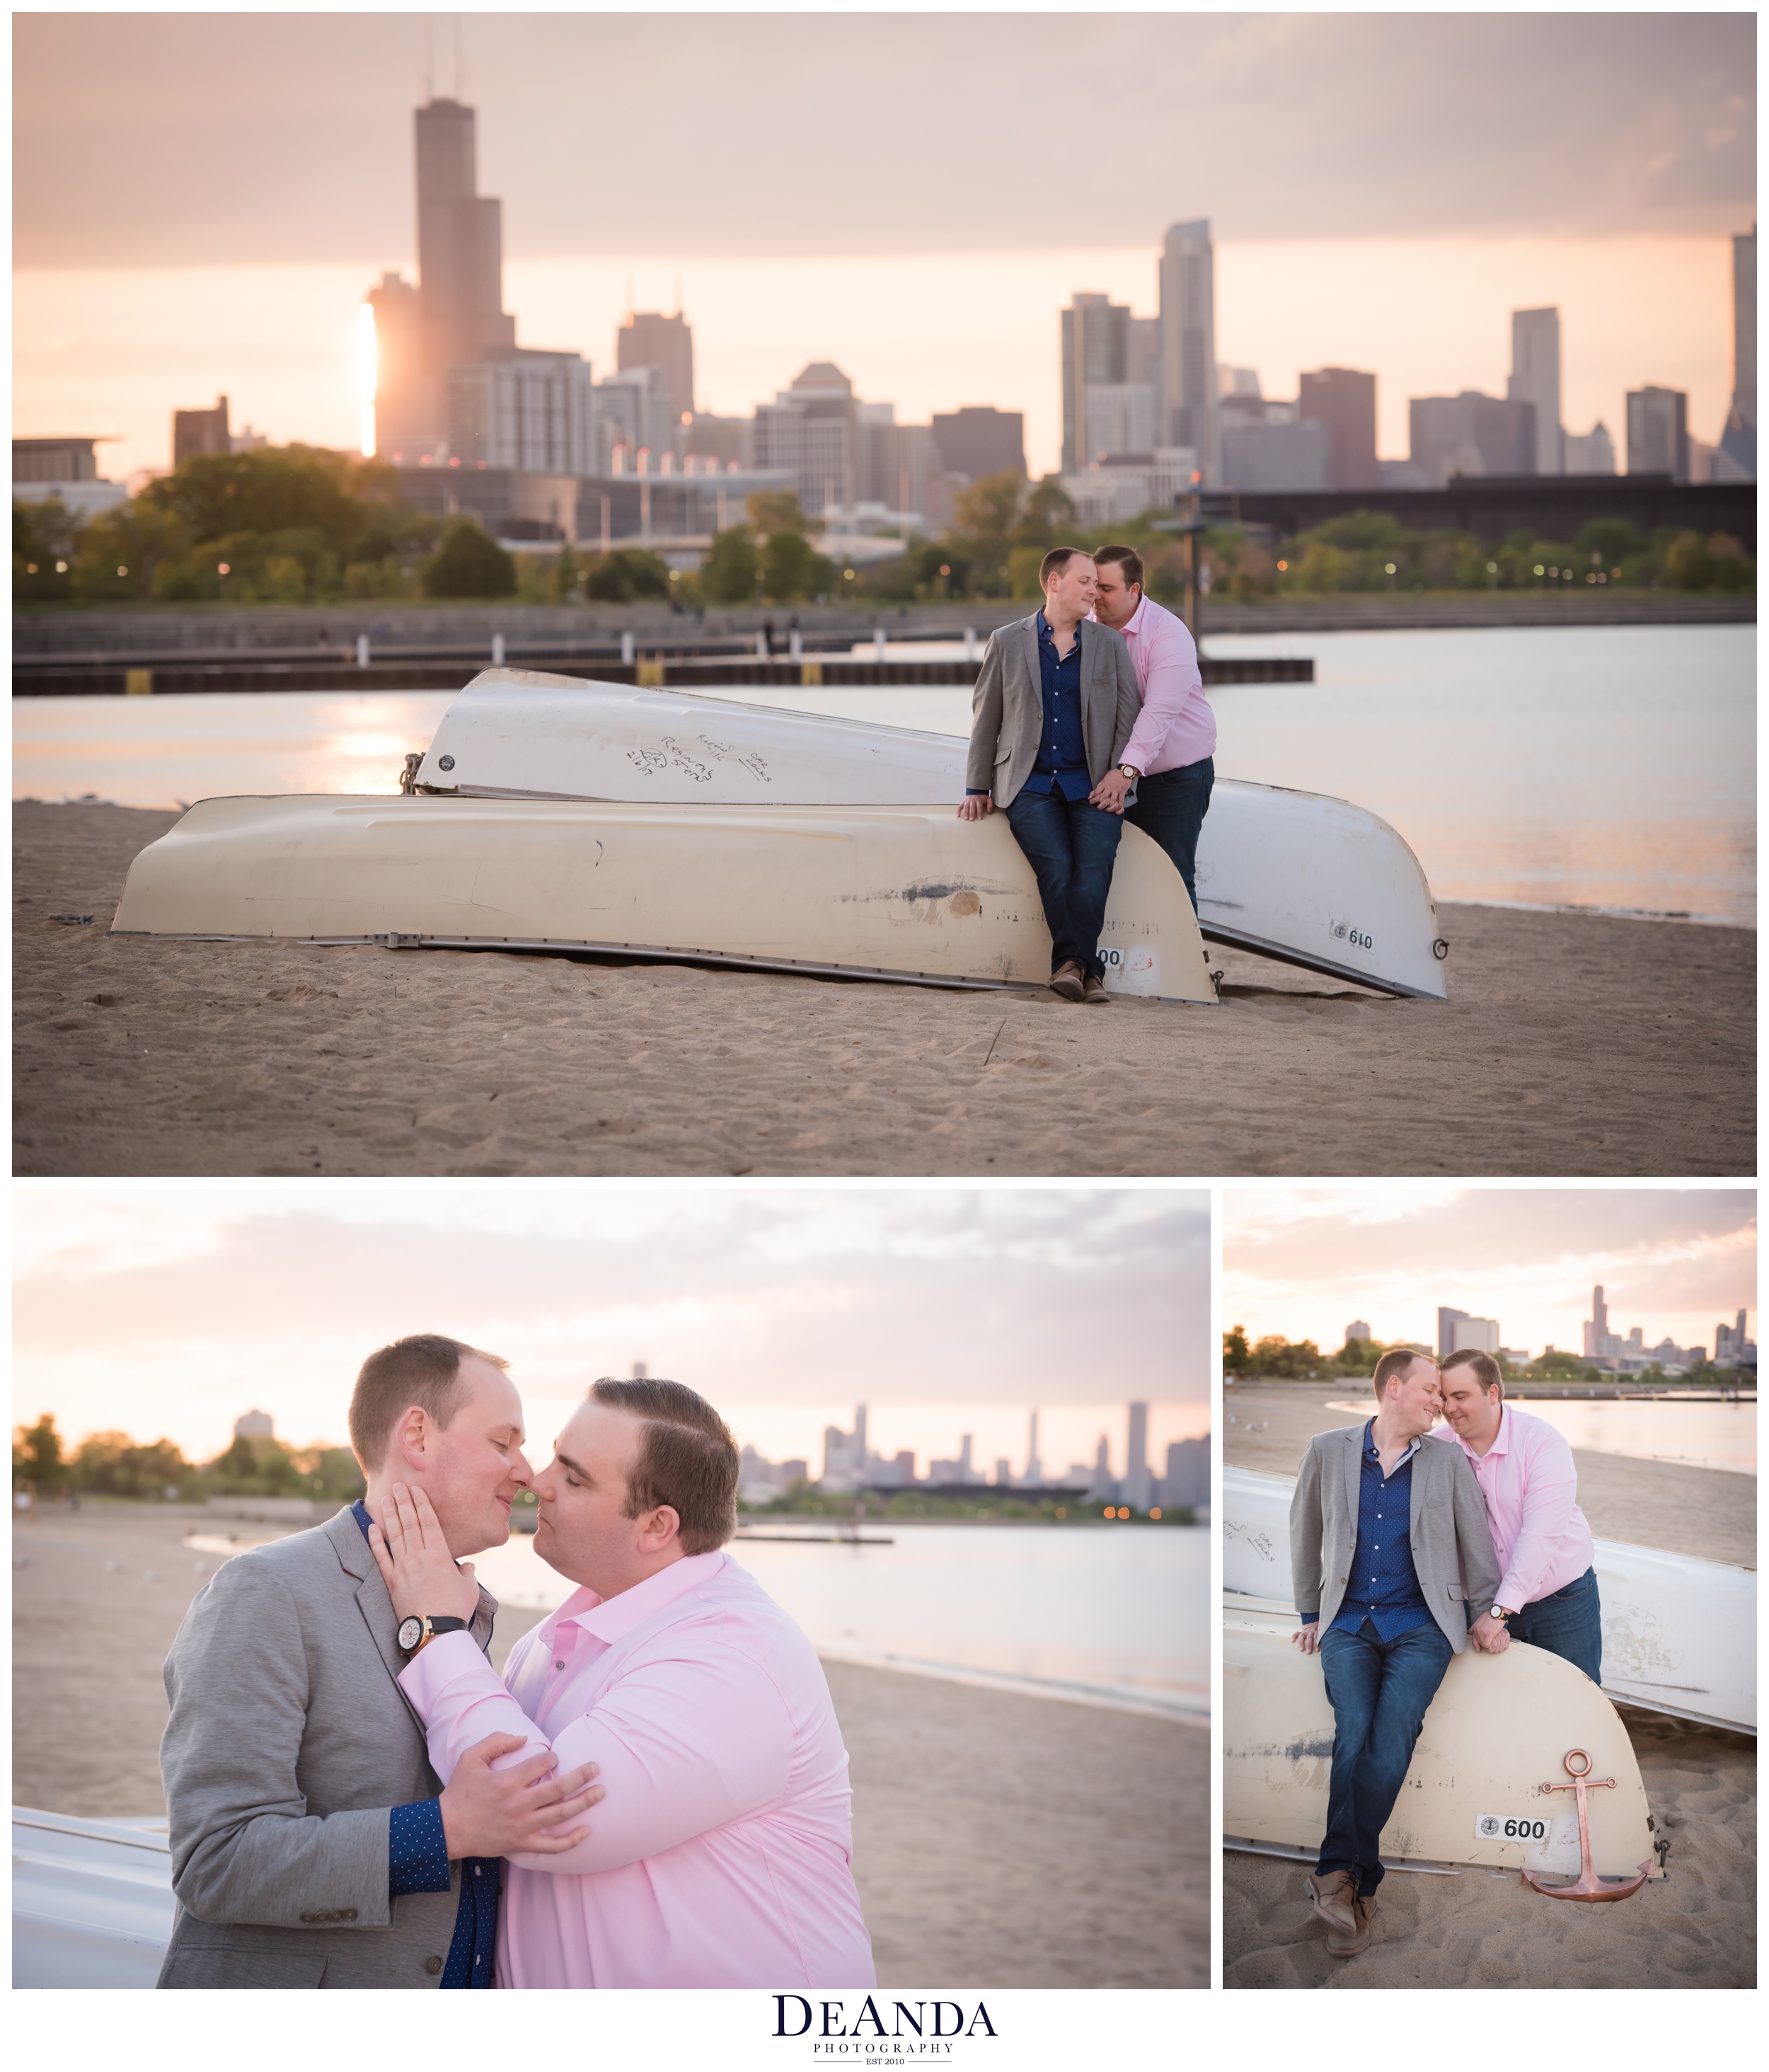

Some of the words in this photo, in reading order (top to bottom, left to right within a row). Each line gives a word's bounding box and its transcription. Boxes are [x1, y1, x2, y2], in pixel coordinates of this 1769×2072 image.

[746, 759, 772, 783] LOCKS
[1098, 949, 1120, 965] 00
[1254, 1538, 1275, 1562] LOCKS
